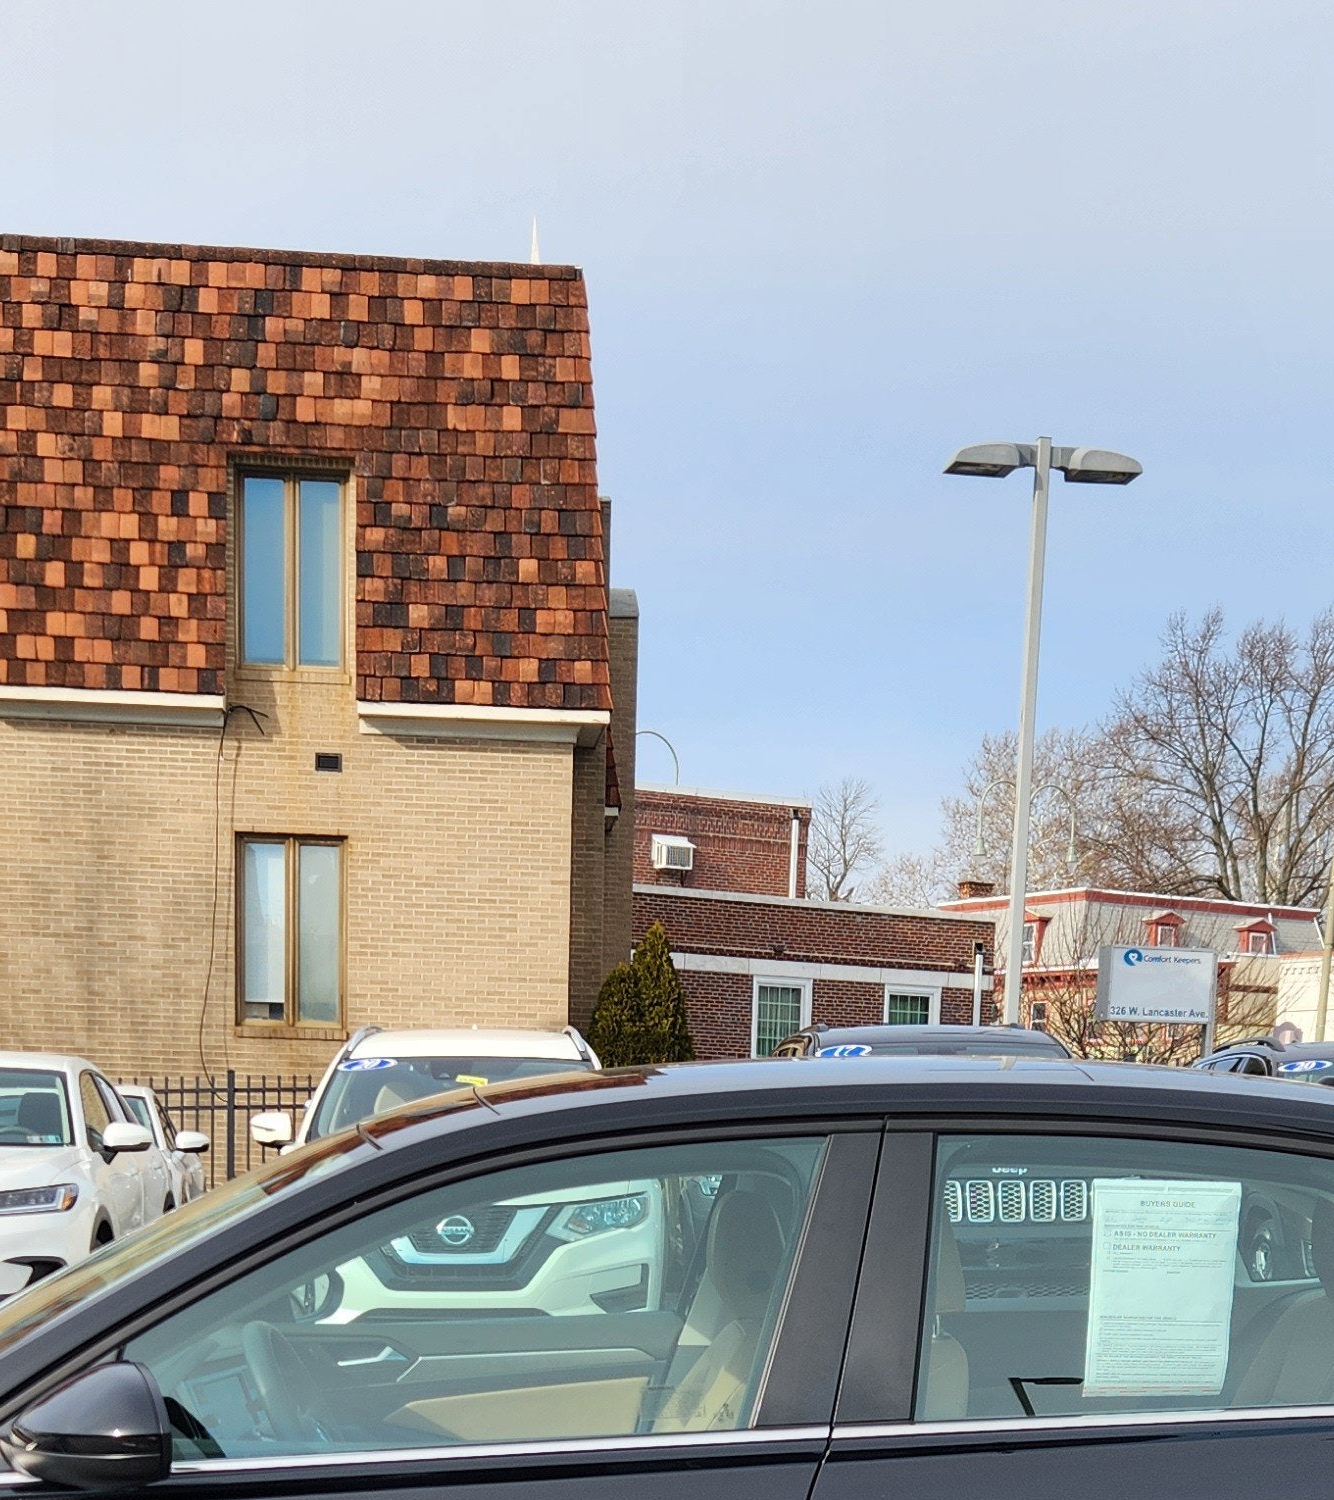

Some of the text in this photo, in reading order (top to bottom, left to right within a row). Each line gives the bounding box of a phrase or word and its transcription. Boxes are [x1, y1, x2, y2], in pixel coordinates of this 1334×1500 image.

[1143, 955, 1202, 965] Comfort Keepers
[1110, 1006, 1208, 1018] 326 W. Lancaster Ave.
[1140, 1200, 1171, 1208] BUYERS
[1112, 1243, 1141, 1251] DEALER
